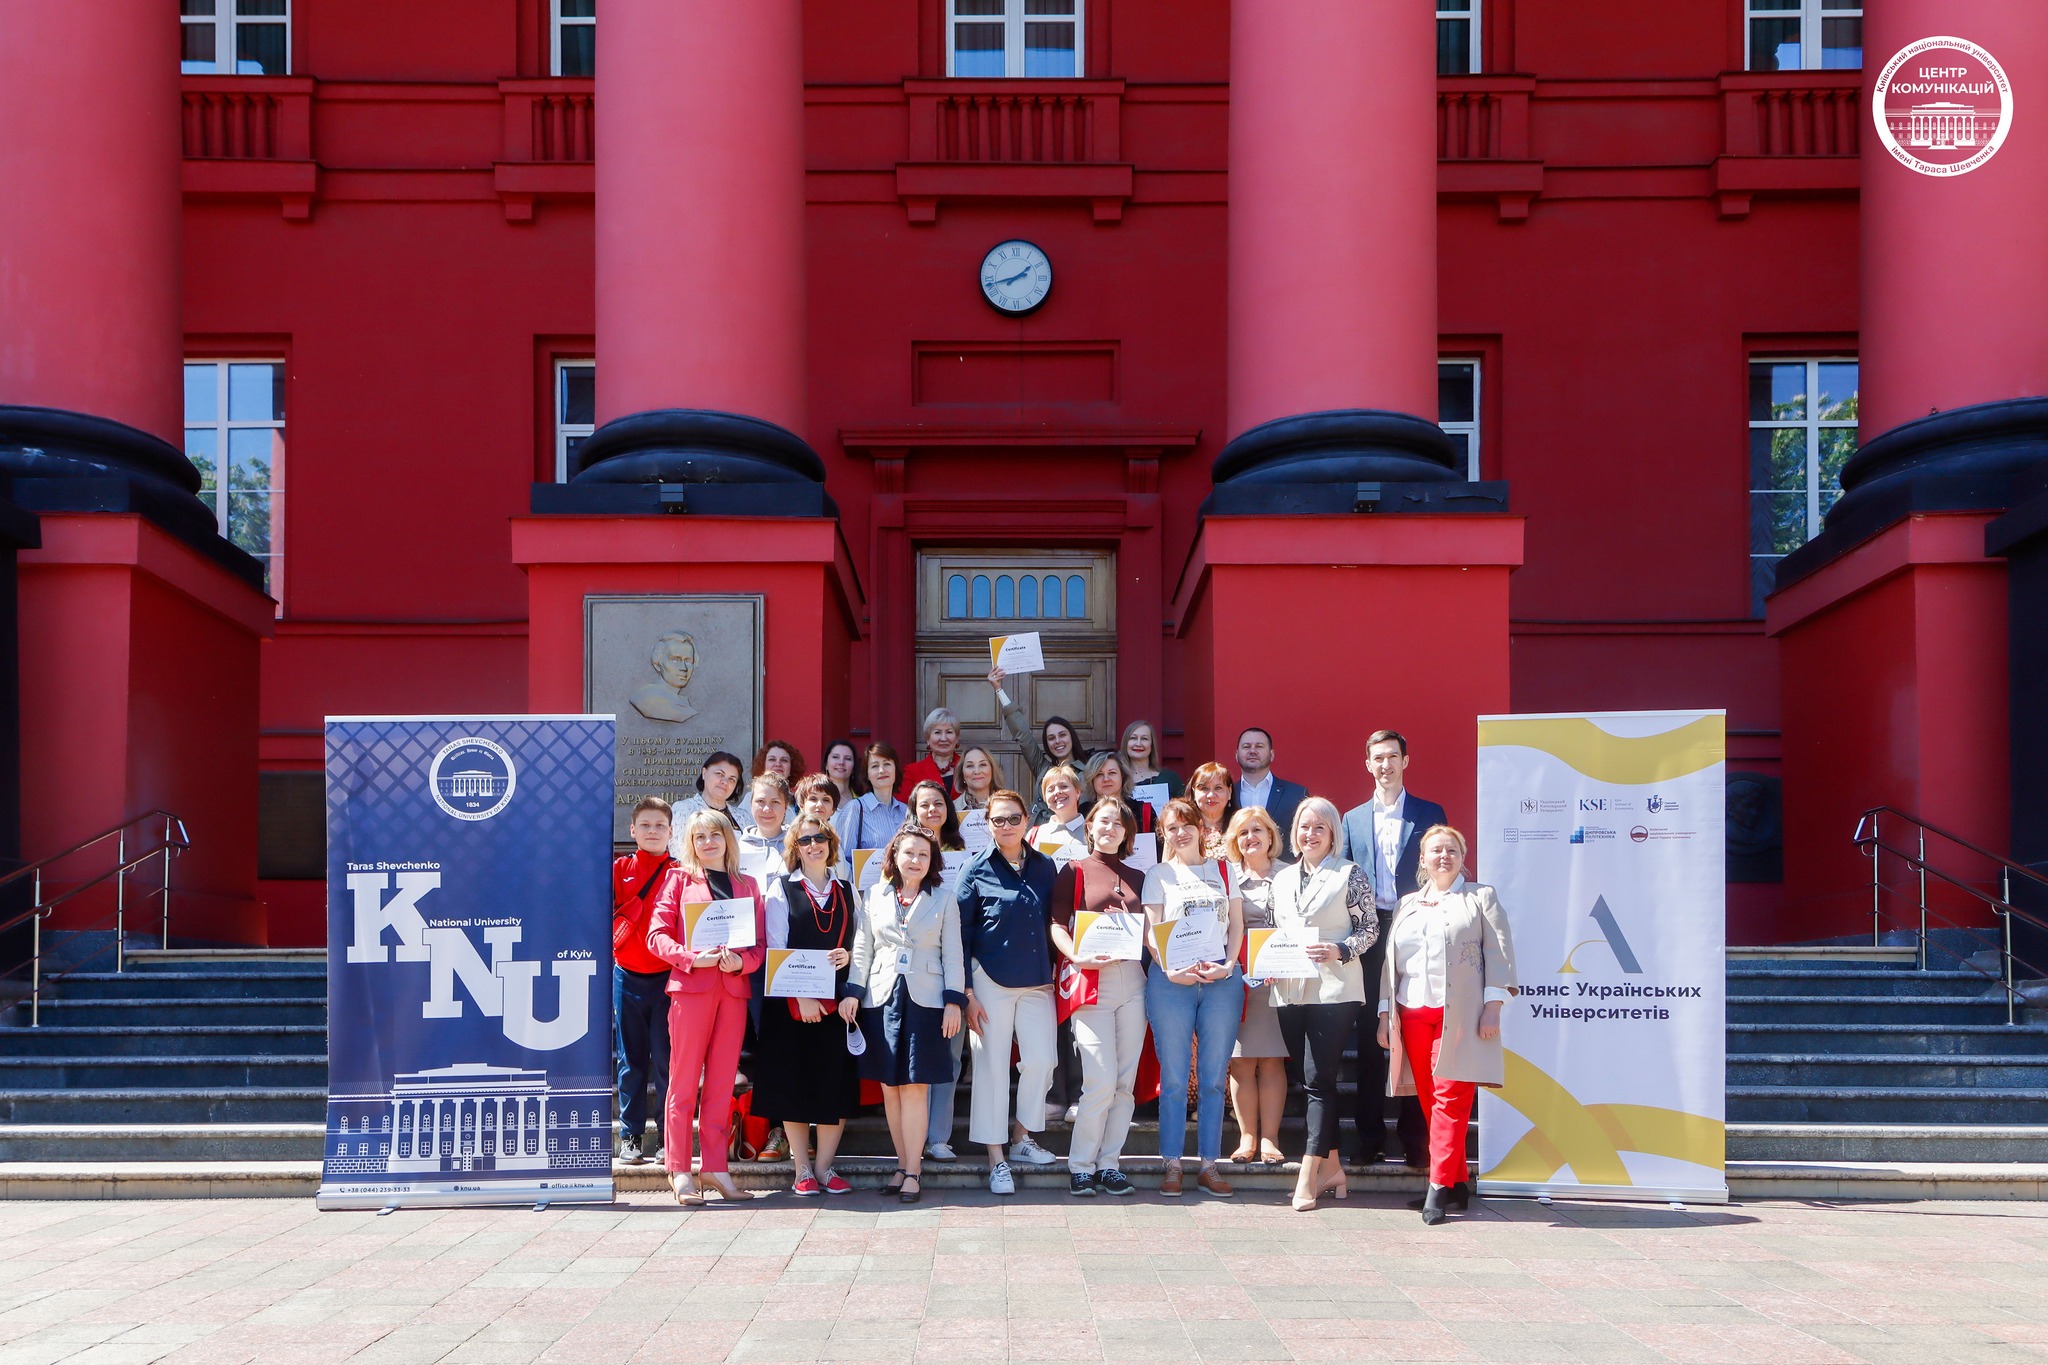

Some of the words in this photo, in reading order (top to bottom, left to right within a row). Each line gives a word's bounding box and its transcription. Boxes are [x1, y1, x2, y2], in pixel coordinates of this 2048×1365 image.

[674, 736, 725, 746] БУДИНКУ
[442, 741, 461, 755] TARAS
[462, 738, 504, 755] SHEVCHENKO
[643, 757, 703, 766] ПРАЦЮВАВ
[622, 767, 702, 777] СПІВРОБІТНИ
[435, 794, 457, 816] NATIONAL
[458, 810, 493, 820] UNIVERSITY
[500, 794, 511, 806] KYIV
[1580, 799, 1607, 811] KSE
[347, 862, 374, 870] Taras
[377, 861, 440, 870] Shevchenko
[429, 918, 472, 927] National
[474, 917, 522, 927] University
[706, 914, 735, 922] Certificate
[1175, 930, 1202, 939] Certificate
[557, 950, 568, 959] of
[570, 949, 592, 960] Kyiv
[1576, 982, 1702, 1000] Українських
[1530, 1004, 1670, 1023] Університетів
